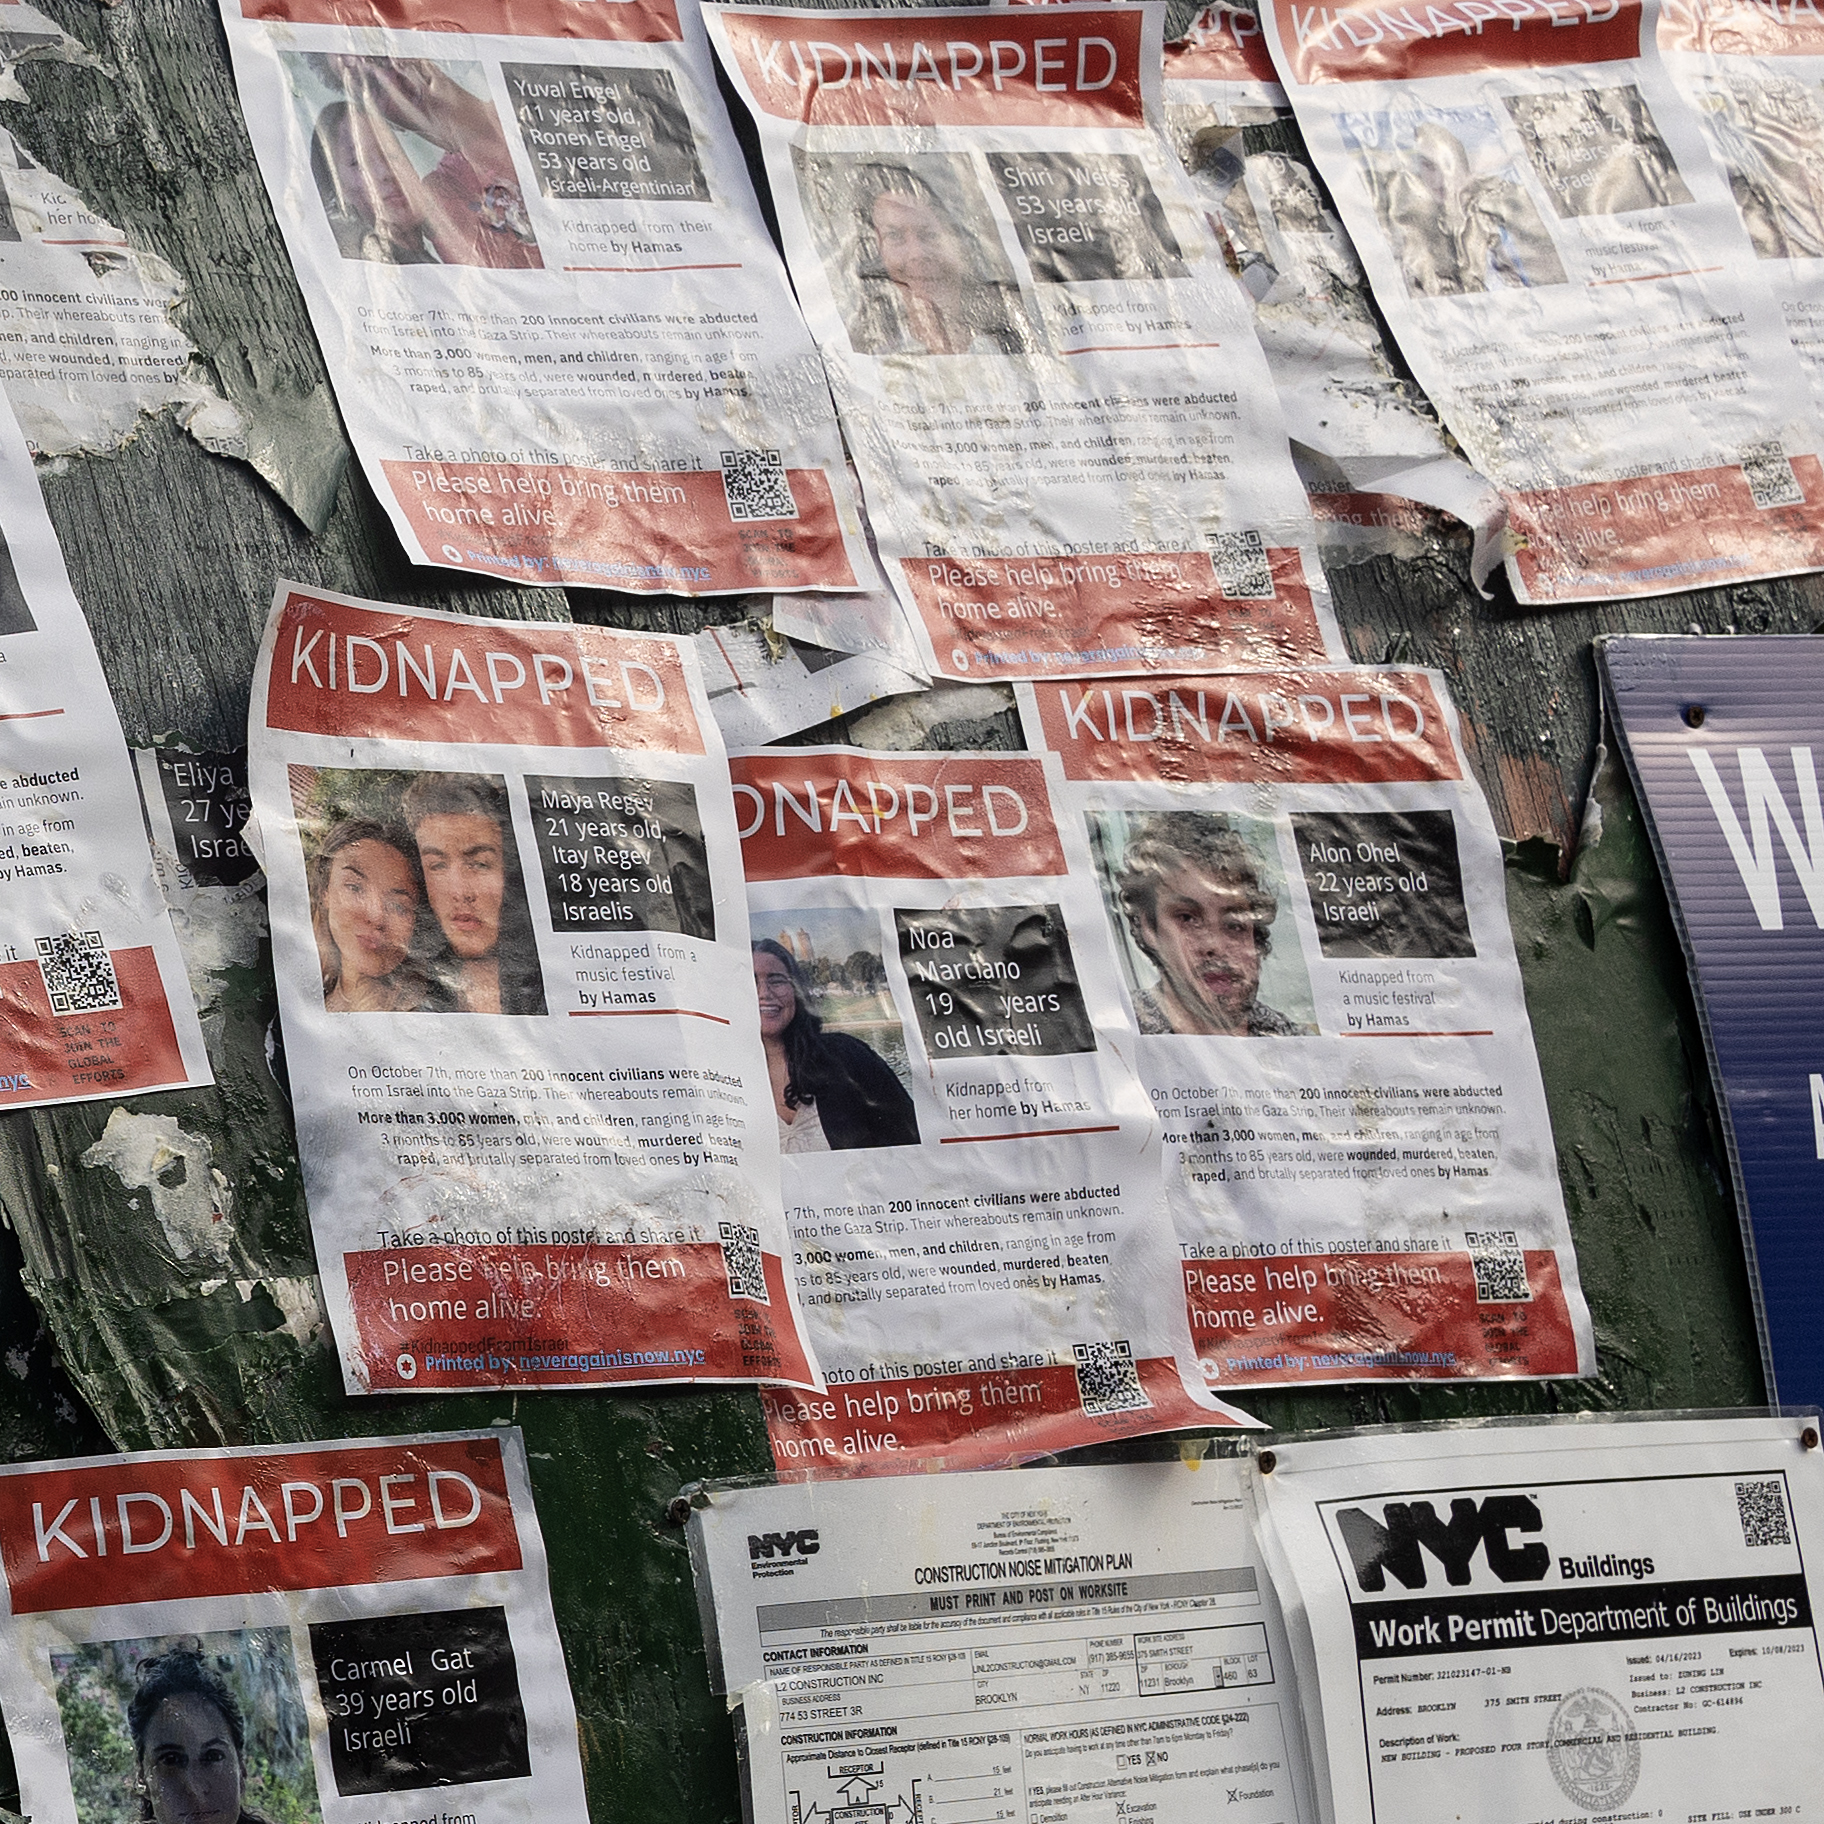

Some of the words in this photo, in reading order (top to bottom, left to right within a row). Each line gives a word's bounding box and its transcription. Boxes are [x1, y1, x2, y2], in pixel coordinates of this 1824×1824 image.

[756, 36, 1118, 94] KIDNAPPED
[513, 79, 566, 99] Yuval
[571, 82, 621, 104] Engel
[530, 128, 592, 147] Ronen
[595, 130, 647, 152] Engel
[1004, 167, 1054, 187] Shiri
[1068, 167, 1129, 188] Weiss
[1027, 223, 1094, 244] Israeli
[22, 290, 81, 304] innocent
[86, 291, 140, 308] civilians
[291, 627, 666, 715] KIDNAPPED
[1062, 690, 1423, 744] KIDNAPPED
[174, 761, 235, 789] Eliya
[542, 791, 593, 814] Maya
[599, 791, 653, 814] Regev
[552, 845, 589, 869] Itay
[594, 845, 651, 869] Regev
[1309, 841, 1350, 863] Alon
[1357, 843, 1400, 864] Ohel
[562, 902, 634, 923] Israelis
[1324, 901, 1380, 923] Israeli
[909, 926, 954, 949] Noa
[916, 959, 1021, 983] Marciano
[1348, 1013, 1366, 1031] by
[1367, 1011, 1410, 1028] Hamas
[935, 1024, 966, 1049] old
[976, 1021, 1043, 1051] Israeli
[32, 1470, 482, 1562] KIDNAPPED
[747, 1529, 821, 1559] NYC
[1336, 1495, 1551, 1592] NYC
[752, 1558, 808, 1570] Environmental
[753, 1568, 794, 1579] Protection
[914, 1563, 1005, 1585] CONSTRUCTION
[1008, 1559, 1042, 1579] NOISE
[1044, 1555, 1104, 1576] MITIGATION
[1106, 1552, 1134, 1571] PLAN
[930, 1595, 959, 1611] MUST
[966, 1592, 995, 1609] PRINT
[1002, 1590, 1023, 1606] AND
[1029, 1587, 1055, 1603] POST
[1059, 1586, 1074, 1601] ON
[1079, 1581, 1128, 1599] WORKSITE
[1370, 1618, 1441, 1647] Work
[1449, 1614, 1537, 1641] Permit
[1542, 1605, 1668, 1637] Department
[1705, 1595, 1798, 1627] Buildings
[331, 1652, 415, 1682] Carmel
[430, 1646, 475, 1672] Gat
[344, 1722, 412, 1752] Israeli
